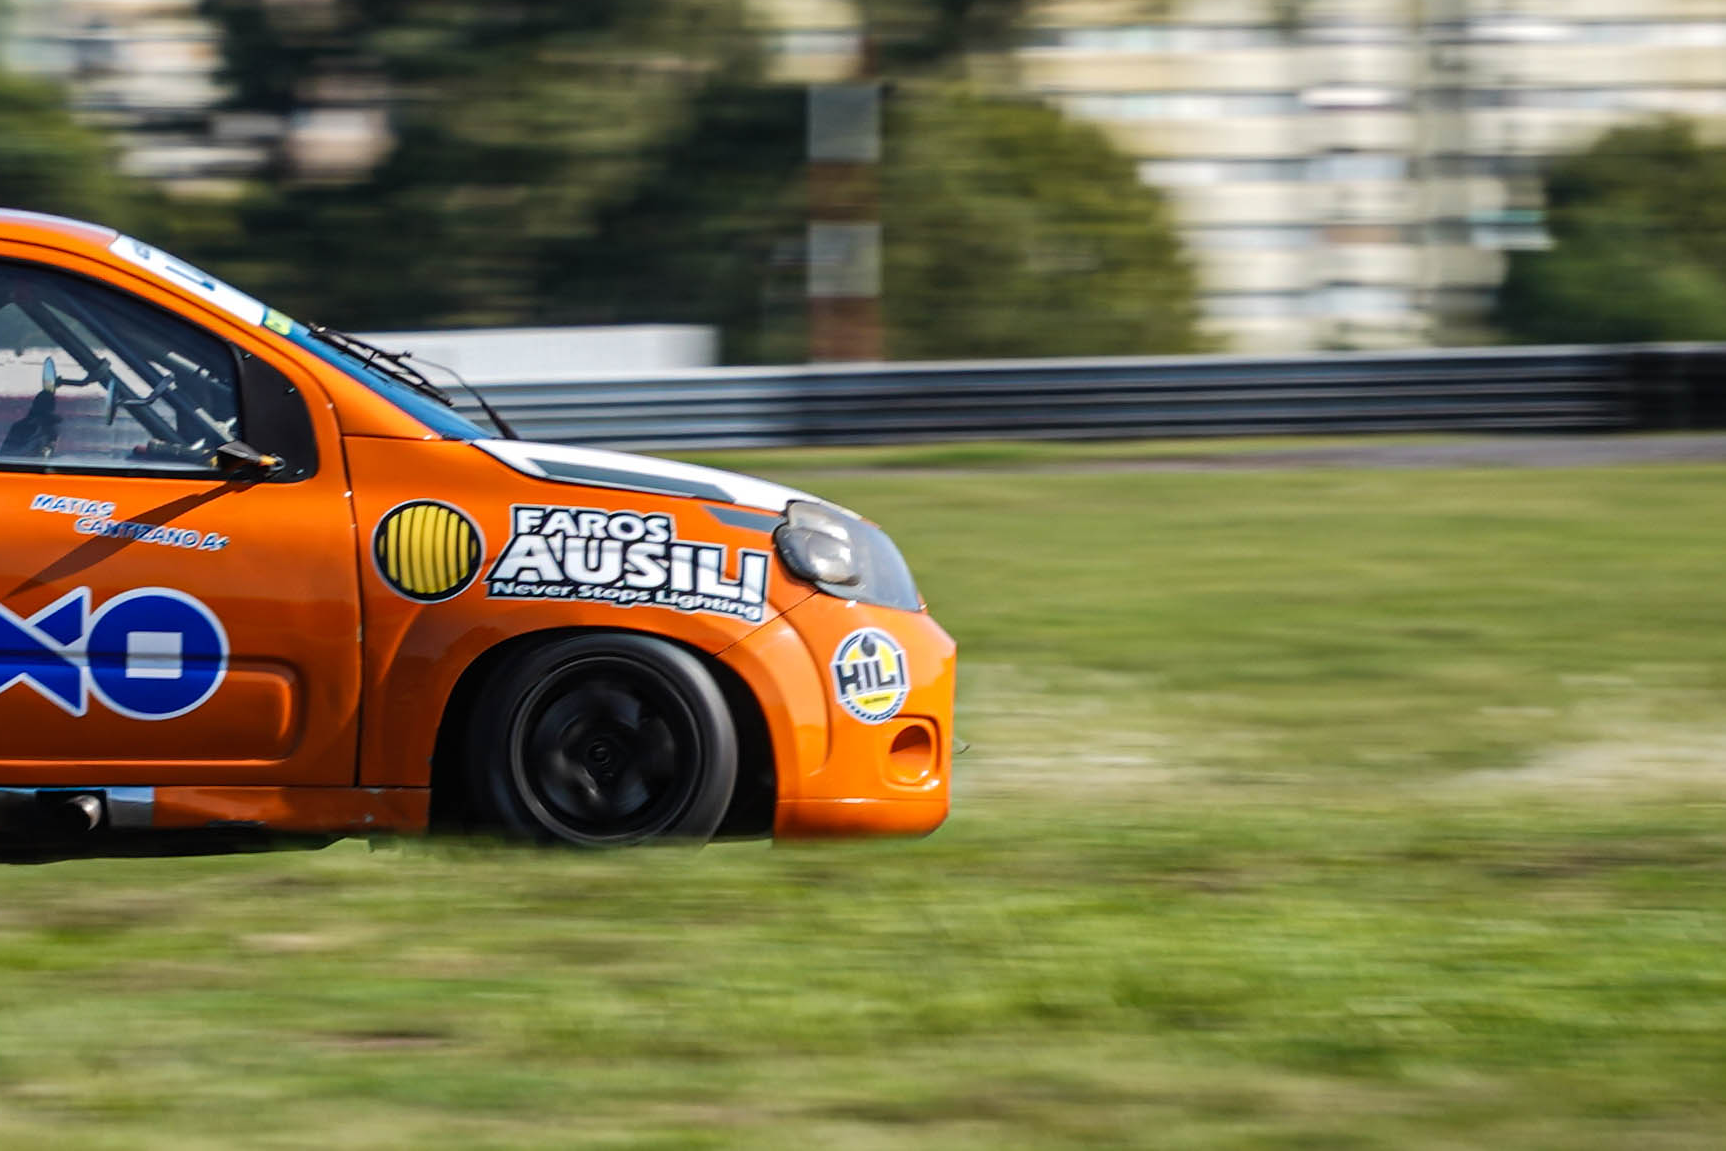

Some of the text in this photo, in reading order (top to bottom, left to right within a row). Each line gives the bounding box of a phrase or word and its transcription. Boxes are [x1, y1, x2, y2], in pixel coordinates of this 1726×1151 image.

[31, 493, 116, 518] MATIAS
[74, 517, 200, 548] CANTIZANO
[515, 508, 672, 543] FAROS
[488, 534, 767, 604] AUSILI
[491, 581, 763, 621] Never Stops Lighting
